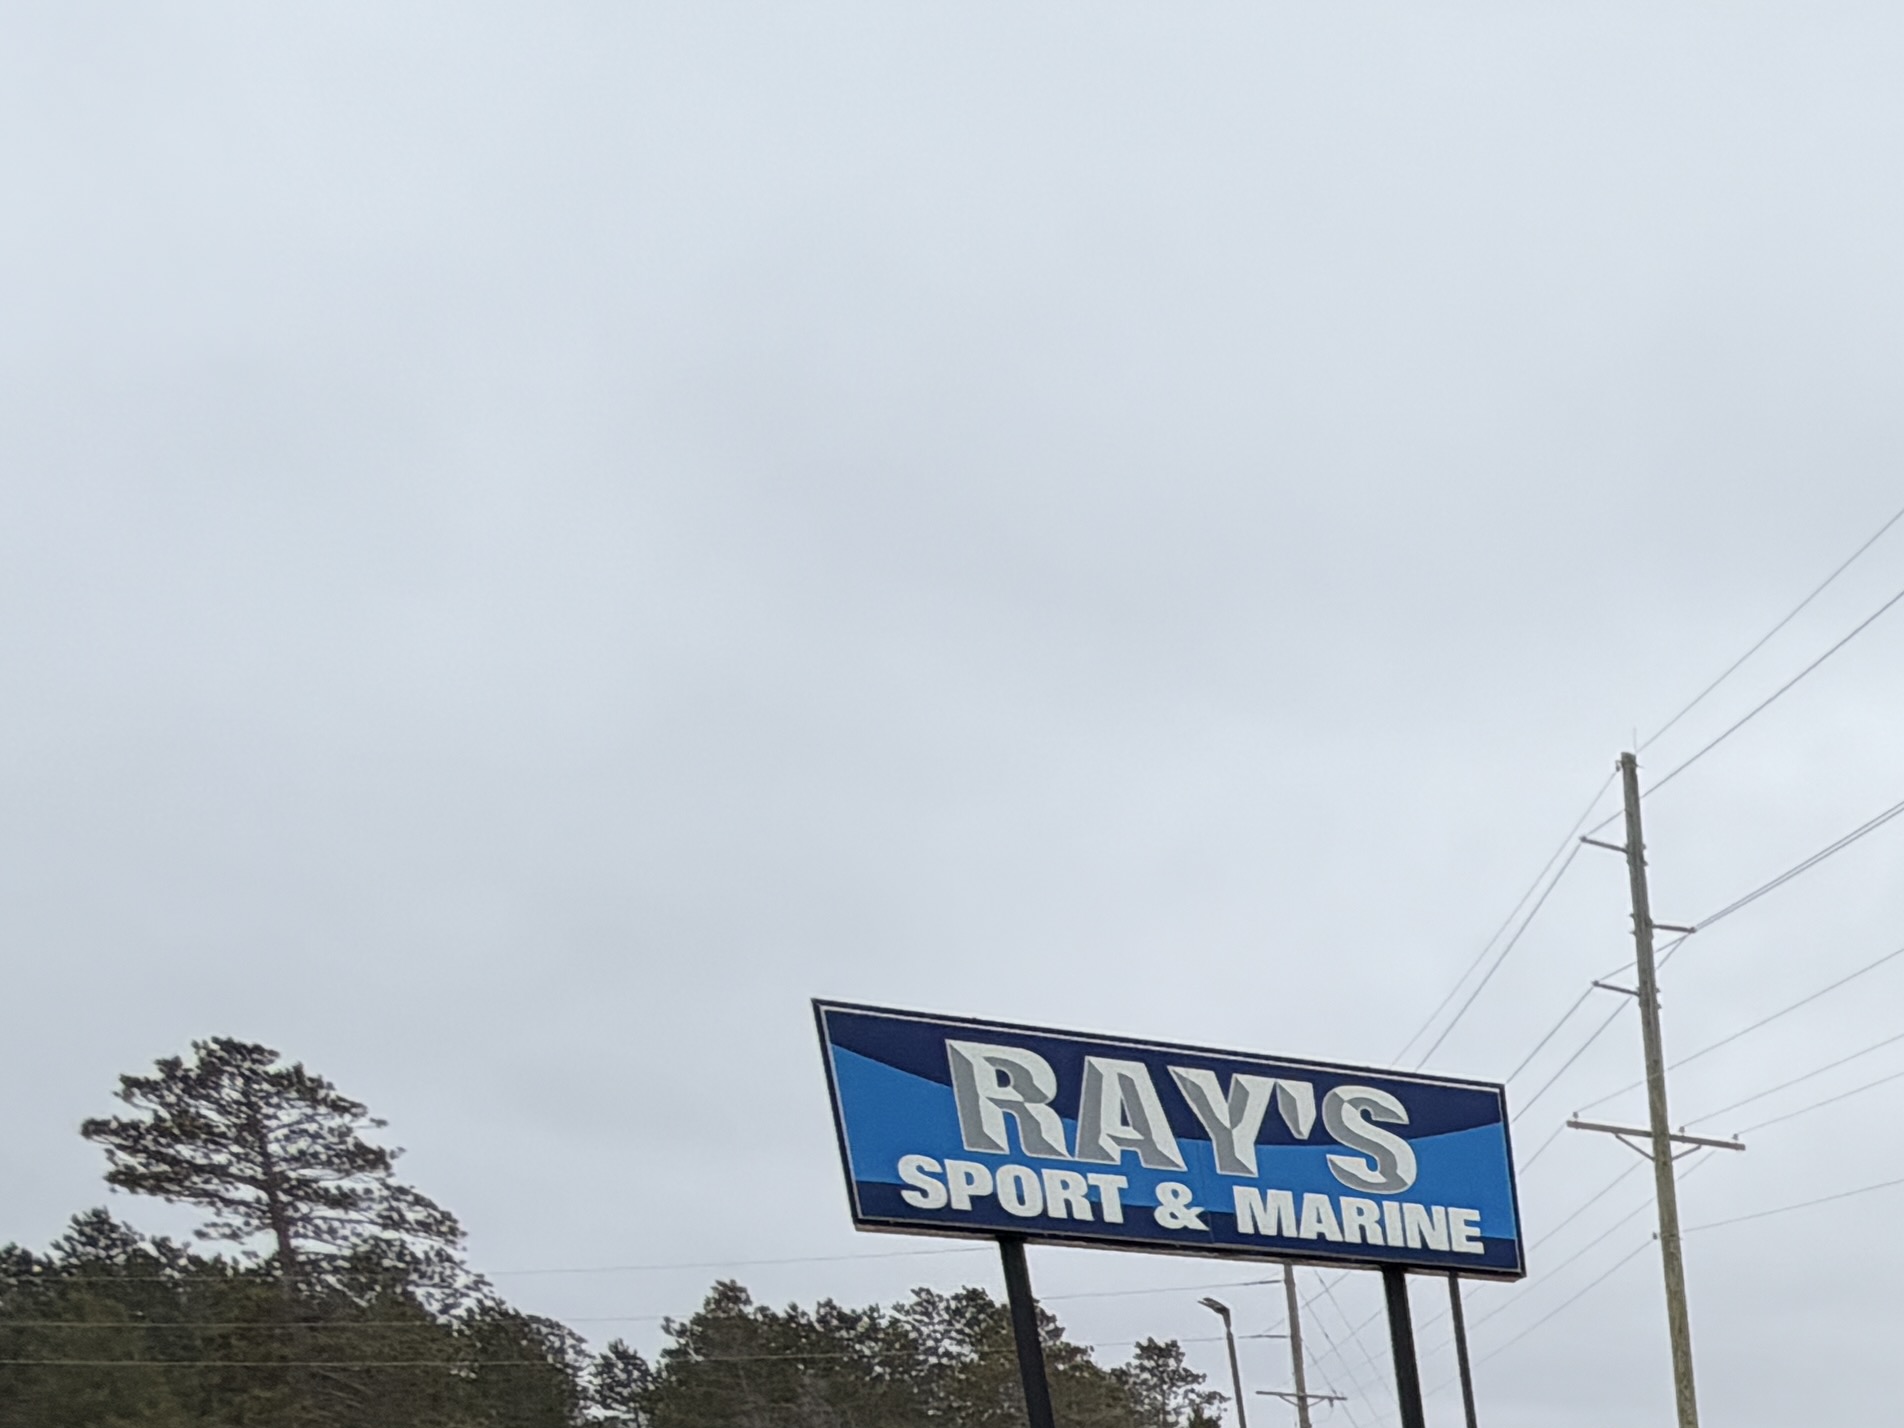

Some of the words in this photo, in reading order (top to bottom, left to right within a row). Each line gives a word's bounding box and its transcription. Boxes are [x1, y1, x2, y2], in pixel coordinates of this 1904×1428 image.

[945, 1038, 1418, 1195] RAY'S
[896, 1154, 1129, 1224] SPORT
[1153, 1181, 1210, 1232] &
[1232, 1185, 1486, 1255] MARINE
